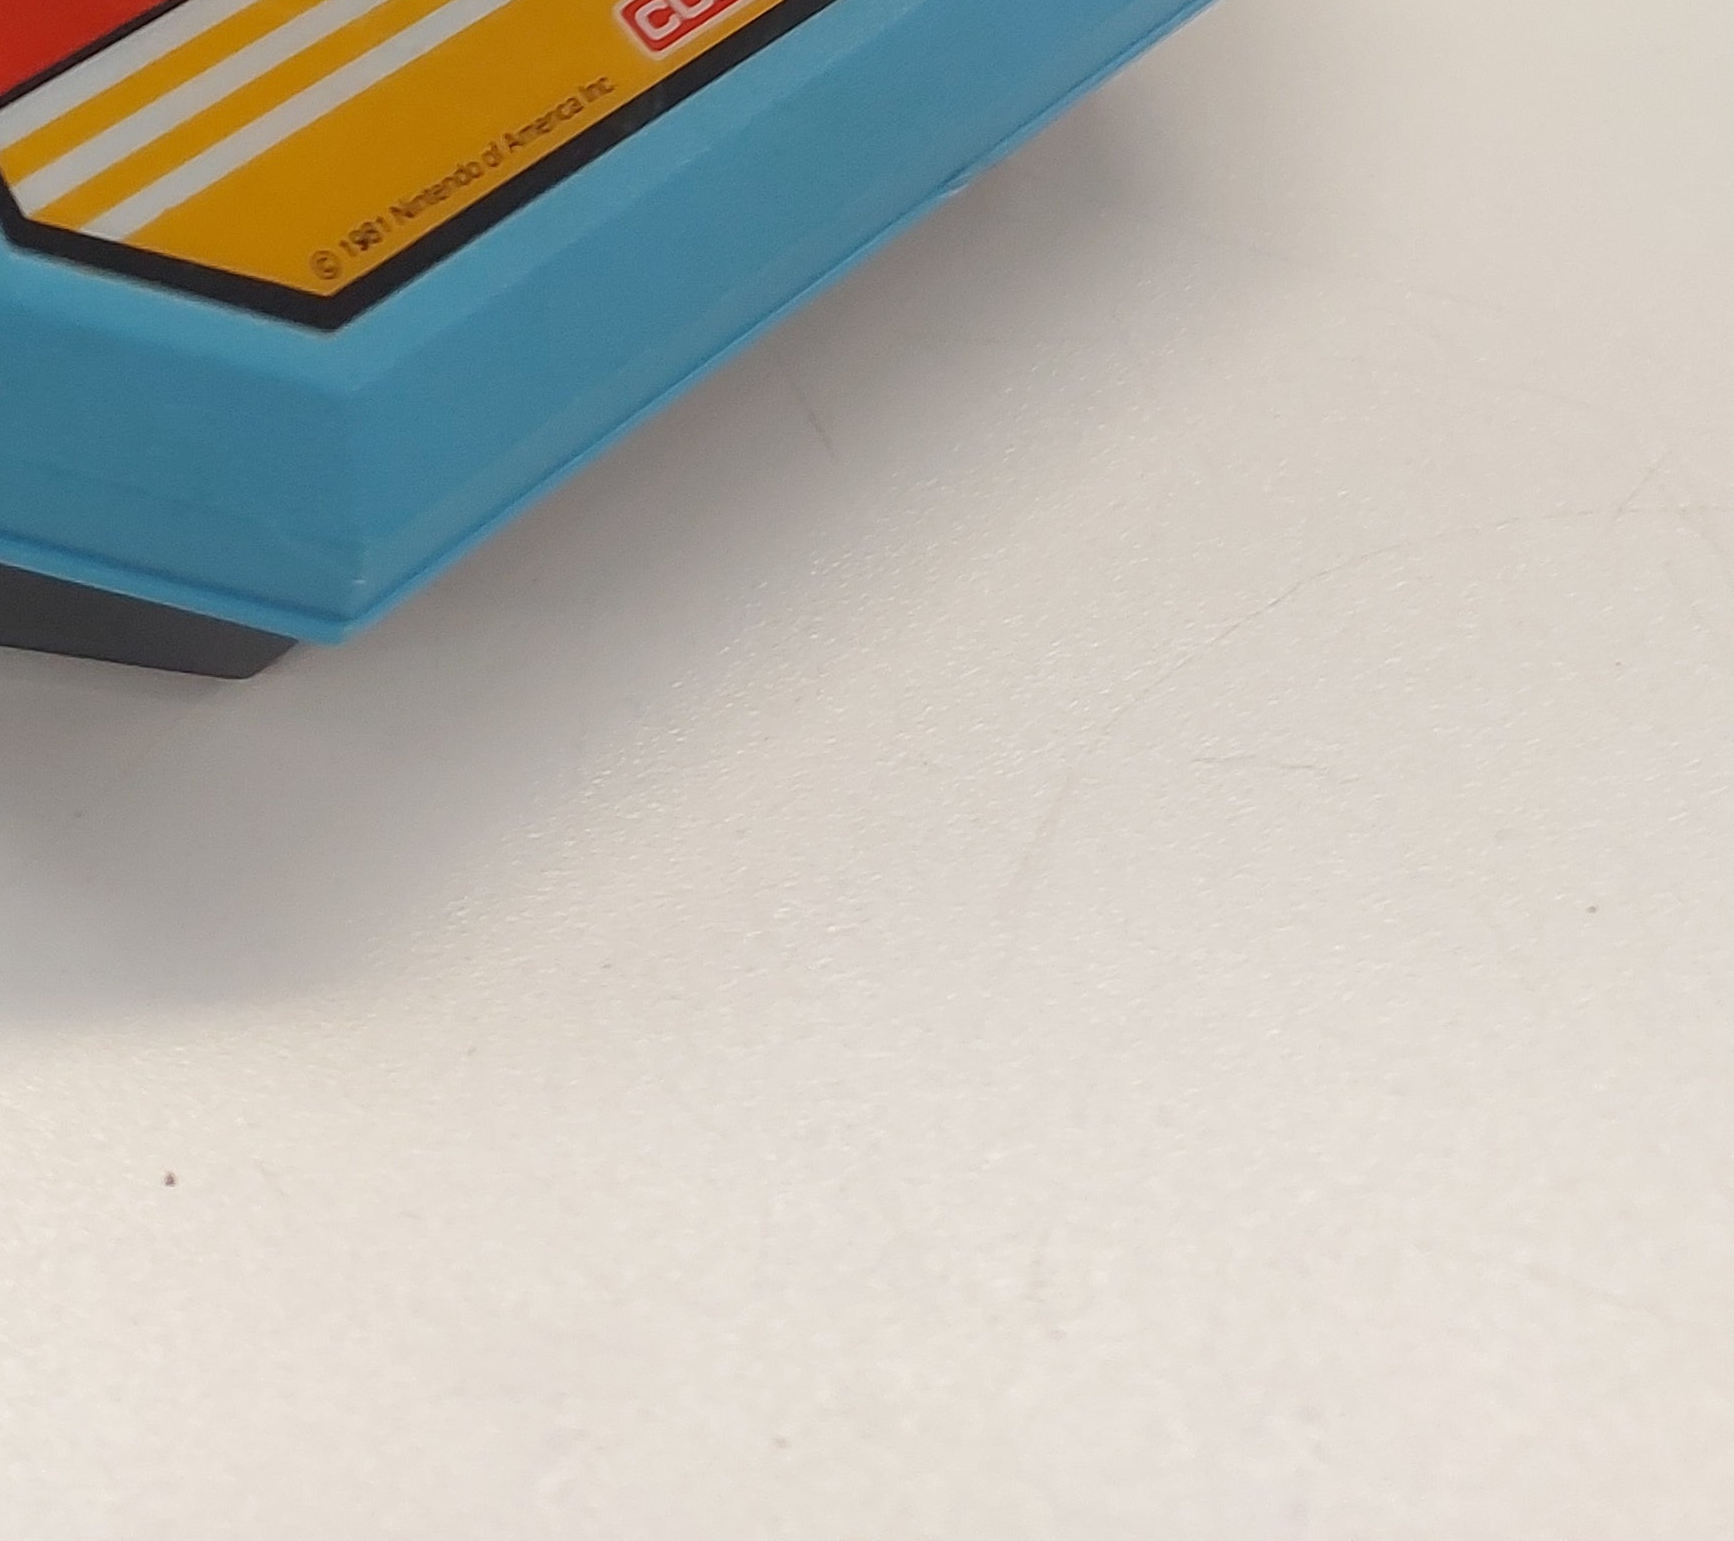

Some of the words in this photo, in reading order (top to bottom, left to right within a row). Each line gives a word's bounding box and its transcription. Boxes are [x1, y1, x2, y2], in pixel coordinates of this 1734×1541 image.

[339, 216, 391, 257] 1981
[390, 163, 484, 225] Nintendo
[481, 140, 504, 167] of
[502, 96, 584, 153] America
